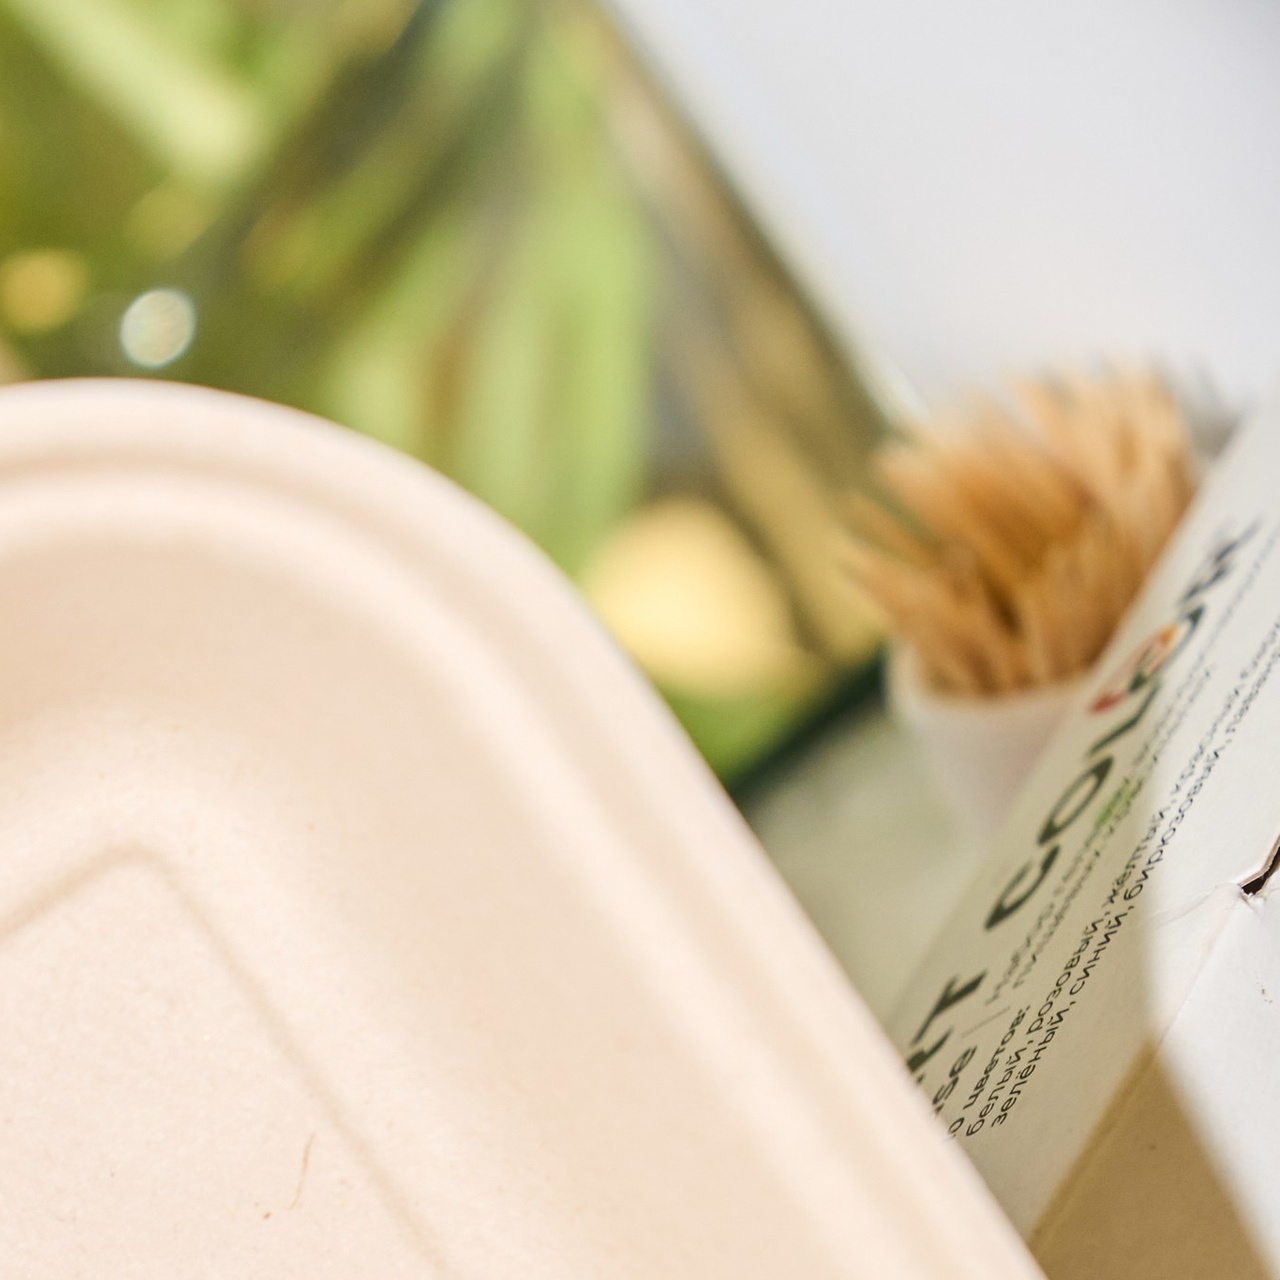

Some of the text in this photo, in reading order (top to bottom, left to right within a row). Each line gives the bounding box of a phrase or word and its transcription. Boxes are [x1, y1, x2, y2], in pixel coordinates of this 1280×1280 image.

[932, 1046, 978, 1118] se
[962, 1005, 1032, 1111] цветов:
[965, 1038, 1035, 1137] белый,
[1025, 910, 1111, 1036] розовый,
[990, 1000, 1077, 1128] зелёный,
[1069, 905, 1135, 997] синий,
